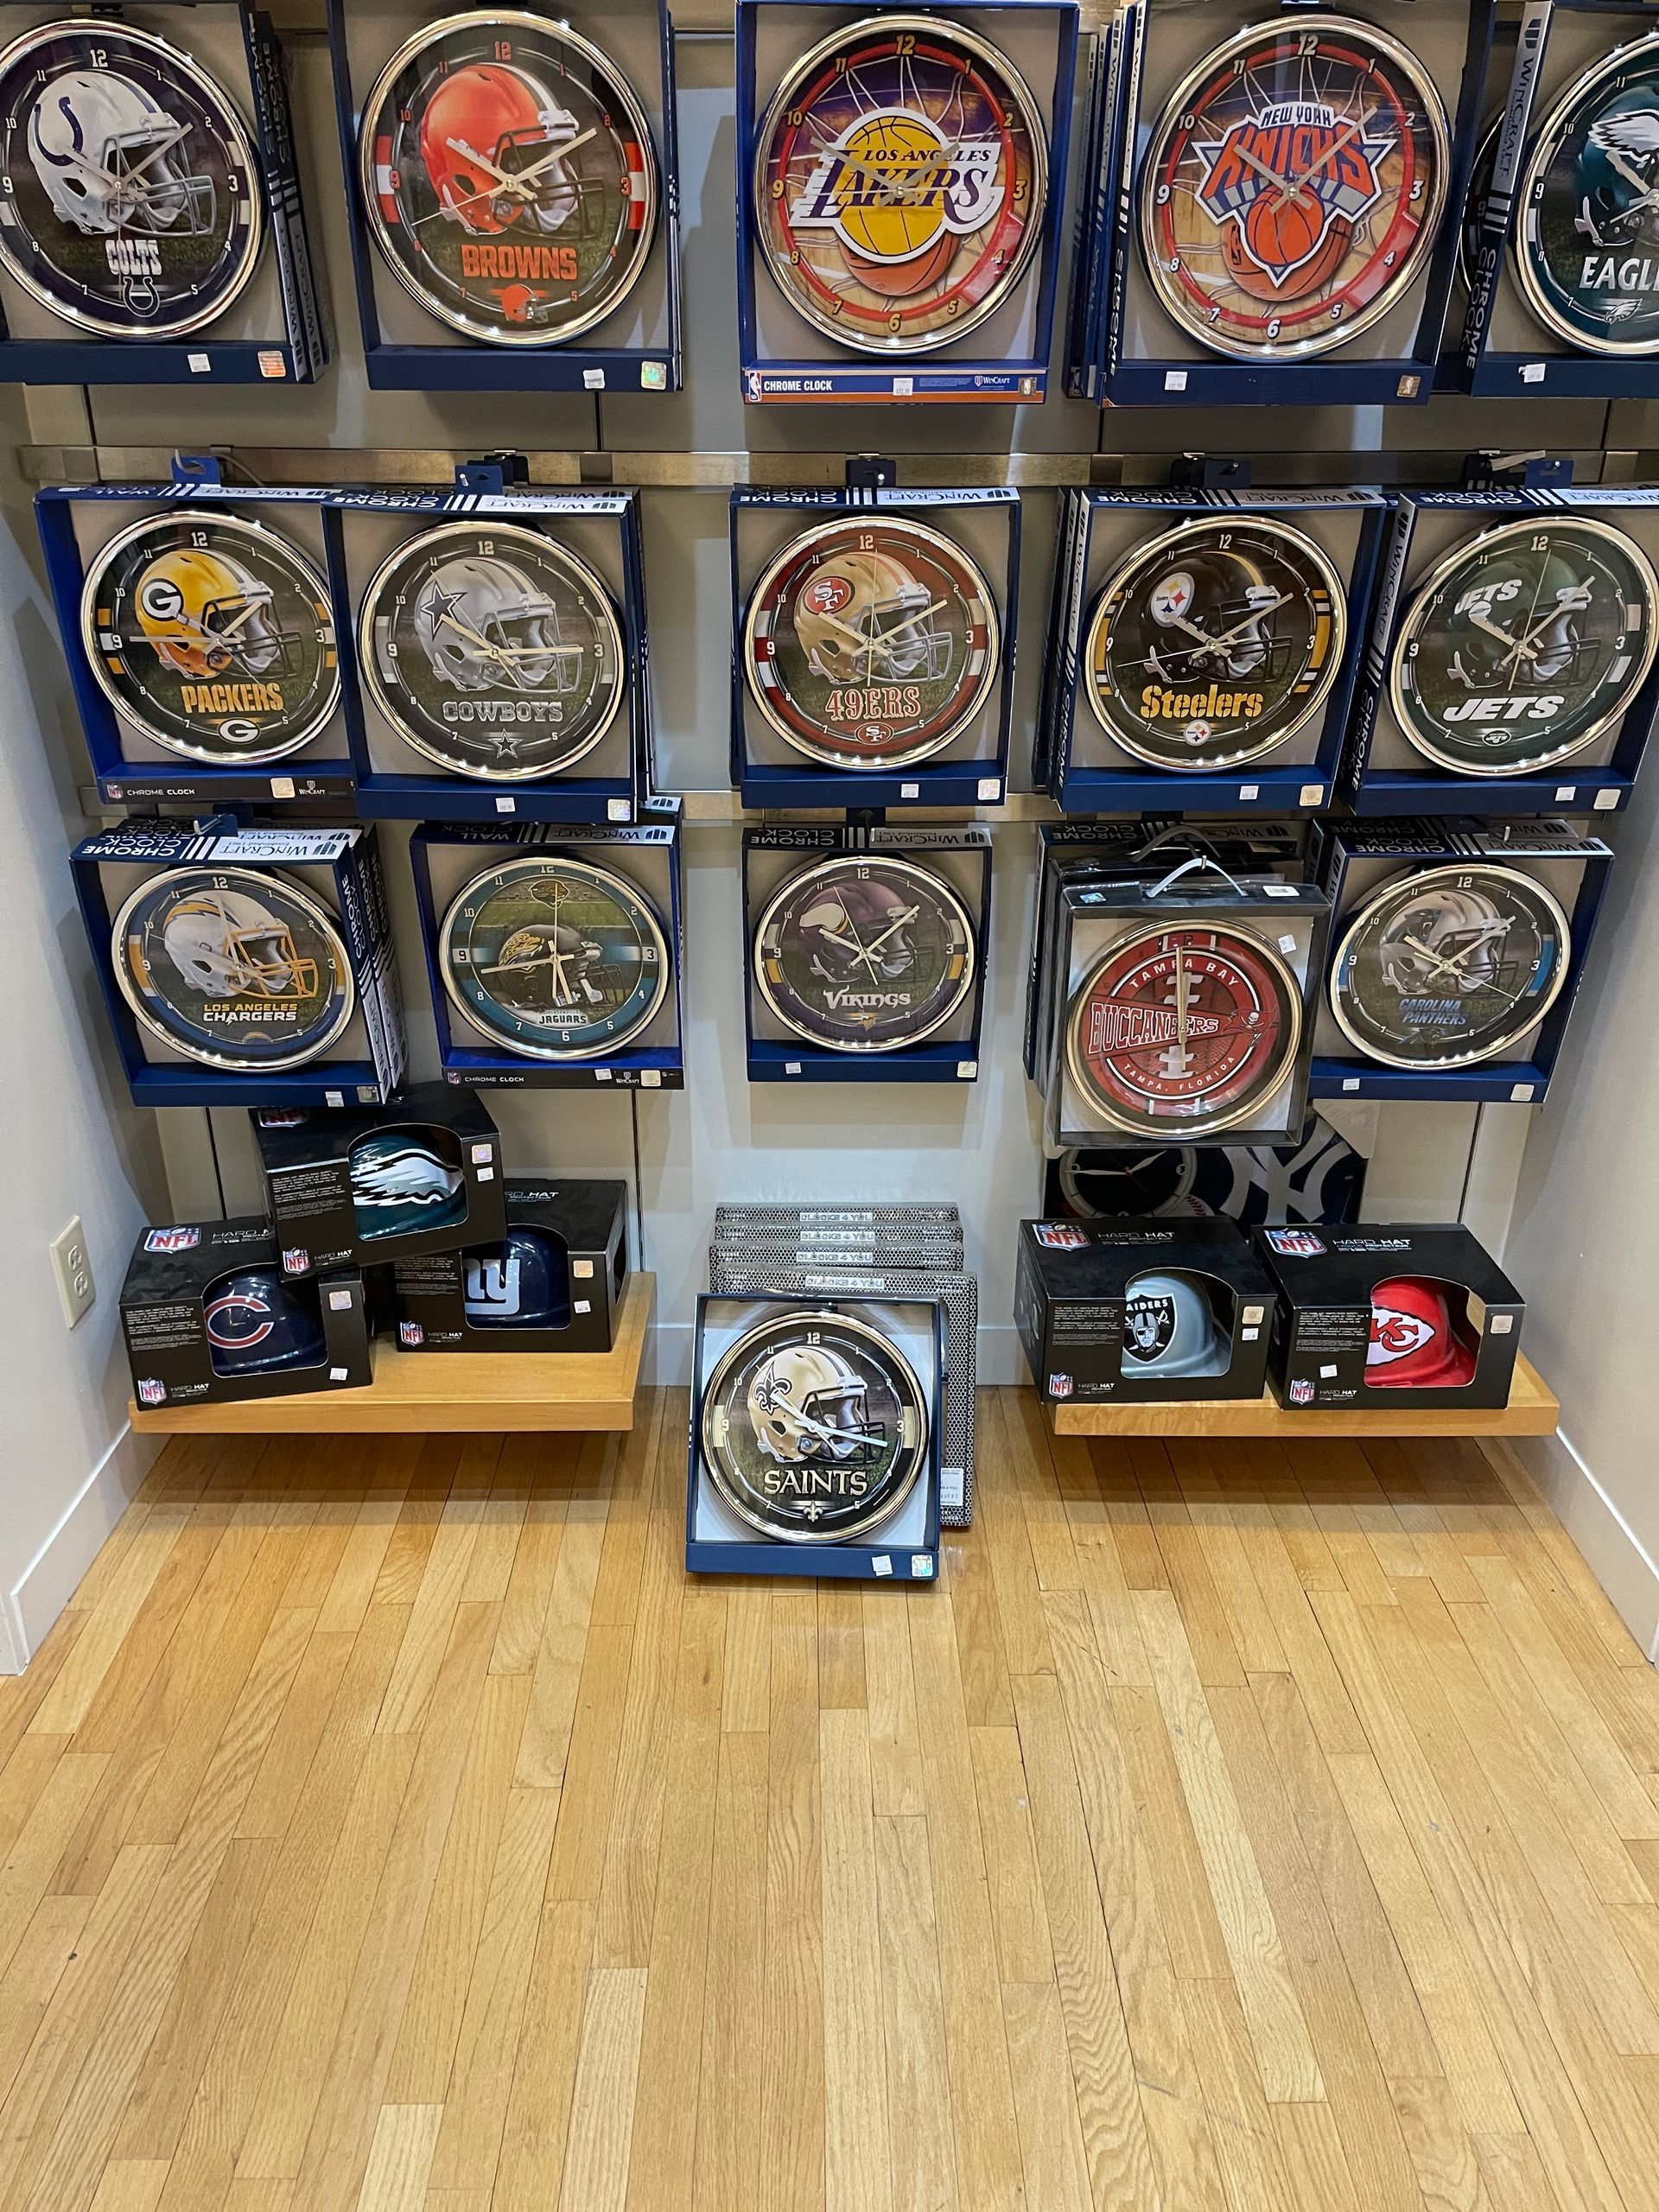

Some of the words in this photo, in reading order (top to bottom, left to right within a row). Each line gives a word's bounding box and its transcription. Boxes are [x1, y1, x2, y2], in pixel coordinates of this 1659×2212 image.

[495, 41, 512, 60] 12
[896, 35, 916, 54] 12
[1296, 35, 1319, 55] 12
[90, 49, 108, 67] 12
[836, 58, 848, 73] 11
[1233, 60, 1245, 74] 11
[788, 111, 803, 127] 10
[1179, 116, 1194, 130] 10
[1261, 110, 1293, 127] NEW
[1296, 107, 1332, 126] YORK
[863, 149, 899, 162] LOS
[900, 149, 991, 162] ANGLES
[1211, 124, 1372, 190] KNICKS
[3, 176, 14, 194] 9
[229, 175, 238, 192] 3
[389, 171, 400, 188] 9
[621, 177, 631, 196] 3
[772, 180, 784, 199] 9
[809, 149, 989, 226] LAKERS
[1014, 180, 1026, 200] 3
[1156, 185, 1170, 204] 9
[1408, 181, 1423, 200] 3
[1535, 183, 1545, 200] 9
[105, 239, 162, 276] COLTS
[461, 245, 578, 280] BROWNS
[992, 250, 1003, 264] 4
[1382, 251, 1395, 265] 4
[1209, 308, 1221, 322] 7
[1466, 248, 1497, 369] CHROME
[888, 314, 901, 332] 6
[1267, 320, 1280, 337] 6
[764, 380, 801, 391] CHROME
[804, 380, 833, 391] CLOCK
[333, 497, 436, 508] CHROME
[1098, 496, 1197, 505] CHROME
[1420, 496, 1522, 505] CHROME
[191, 532, 207, 547] 12
[859, 536, 874, 550] 12
[1218, 535, 1231, 550] 12
[1530, 536, 1549, 551] 12
[478, 541, 494, 556] 12
[141, 582, 179, 618] G
[1454, 580, 1522, 615] JETS
[111, 634, 123, 649] 9
[1615, 635, 1625, 650] 3
[181, 683, 283, 714] PACKERS
[824, 686, 922, 721] 49ERS
[1140, 684, 1264, 719] Steelers
[442, 701, 563, 722] COWBOYS
[1443, 696, 1565, 721] JETS
[219, 721, 259, 742] G
[1351, 696, 1374, 791] CHROME
[751, 836, 834, 846] CHROME
[82, 845, 175, 856] CHROME
[220, 843, 308, 855] WINCRAFT
[857, 868, 869, 880] 12
[213, 877, 228, 889] 12
[1457, 877, 1472, 888] 12
[342, 874, 361, 959] CHROME
[1206, 963, 1239, 987] BAY
[823, 985, 911, 1009] VIKINGS
[1398, 999, 1461, 1012] CAROLINA
[203, 1011, 296, 1024] CHARGERS
[539, 1014, 587, 1024] JAGUARS
[1402, 1013, 1467, 1026] PANTHERS
[1089, 1002, 1218, 1054] BUCCANEERS
[1179, 1057, 1235, 1090] FLORIDA
[154, 1234, 198, 1249] NFL
[213, 1230, 257, 1238] HARD
[1043, 1232, 1086, 1245] NFL
[1278, 1239, 1322, 1252] NFL
[289, 1257, 308, 1269] NFL
[1126, 1299, 1169, 1312] AIDERS
[405, 1332, 423, 1341] NFL
[807, 1332, 820, 1344] 12
[145, 1387, 163, 1399] NFL
[1054, 1383, 1072, 1394] NFL
[1294, 1389, 1314, 1399] NFL
[764, 1468, 868, 1497] SAINTS
